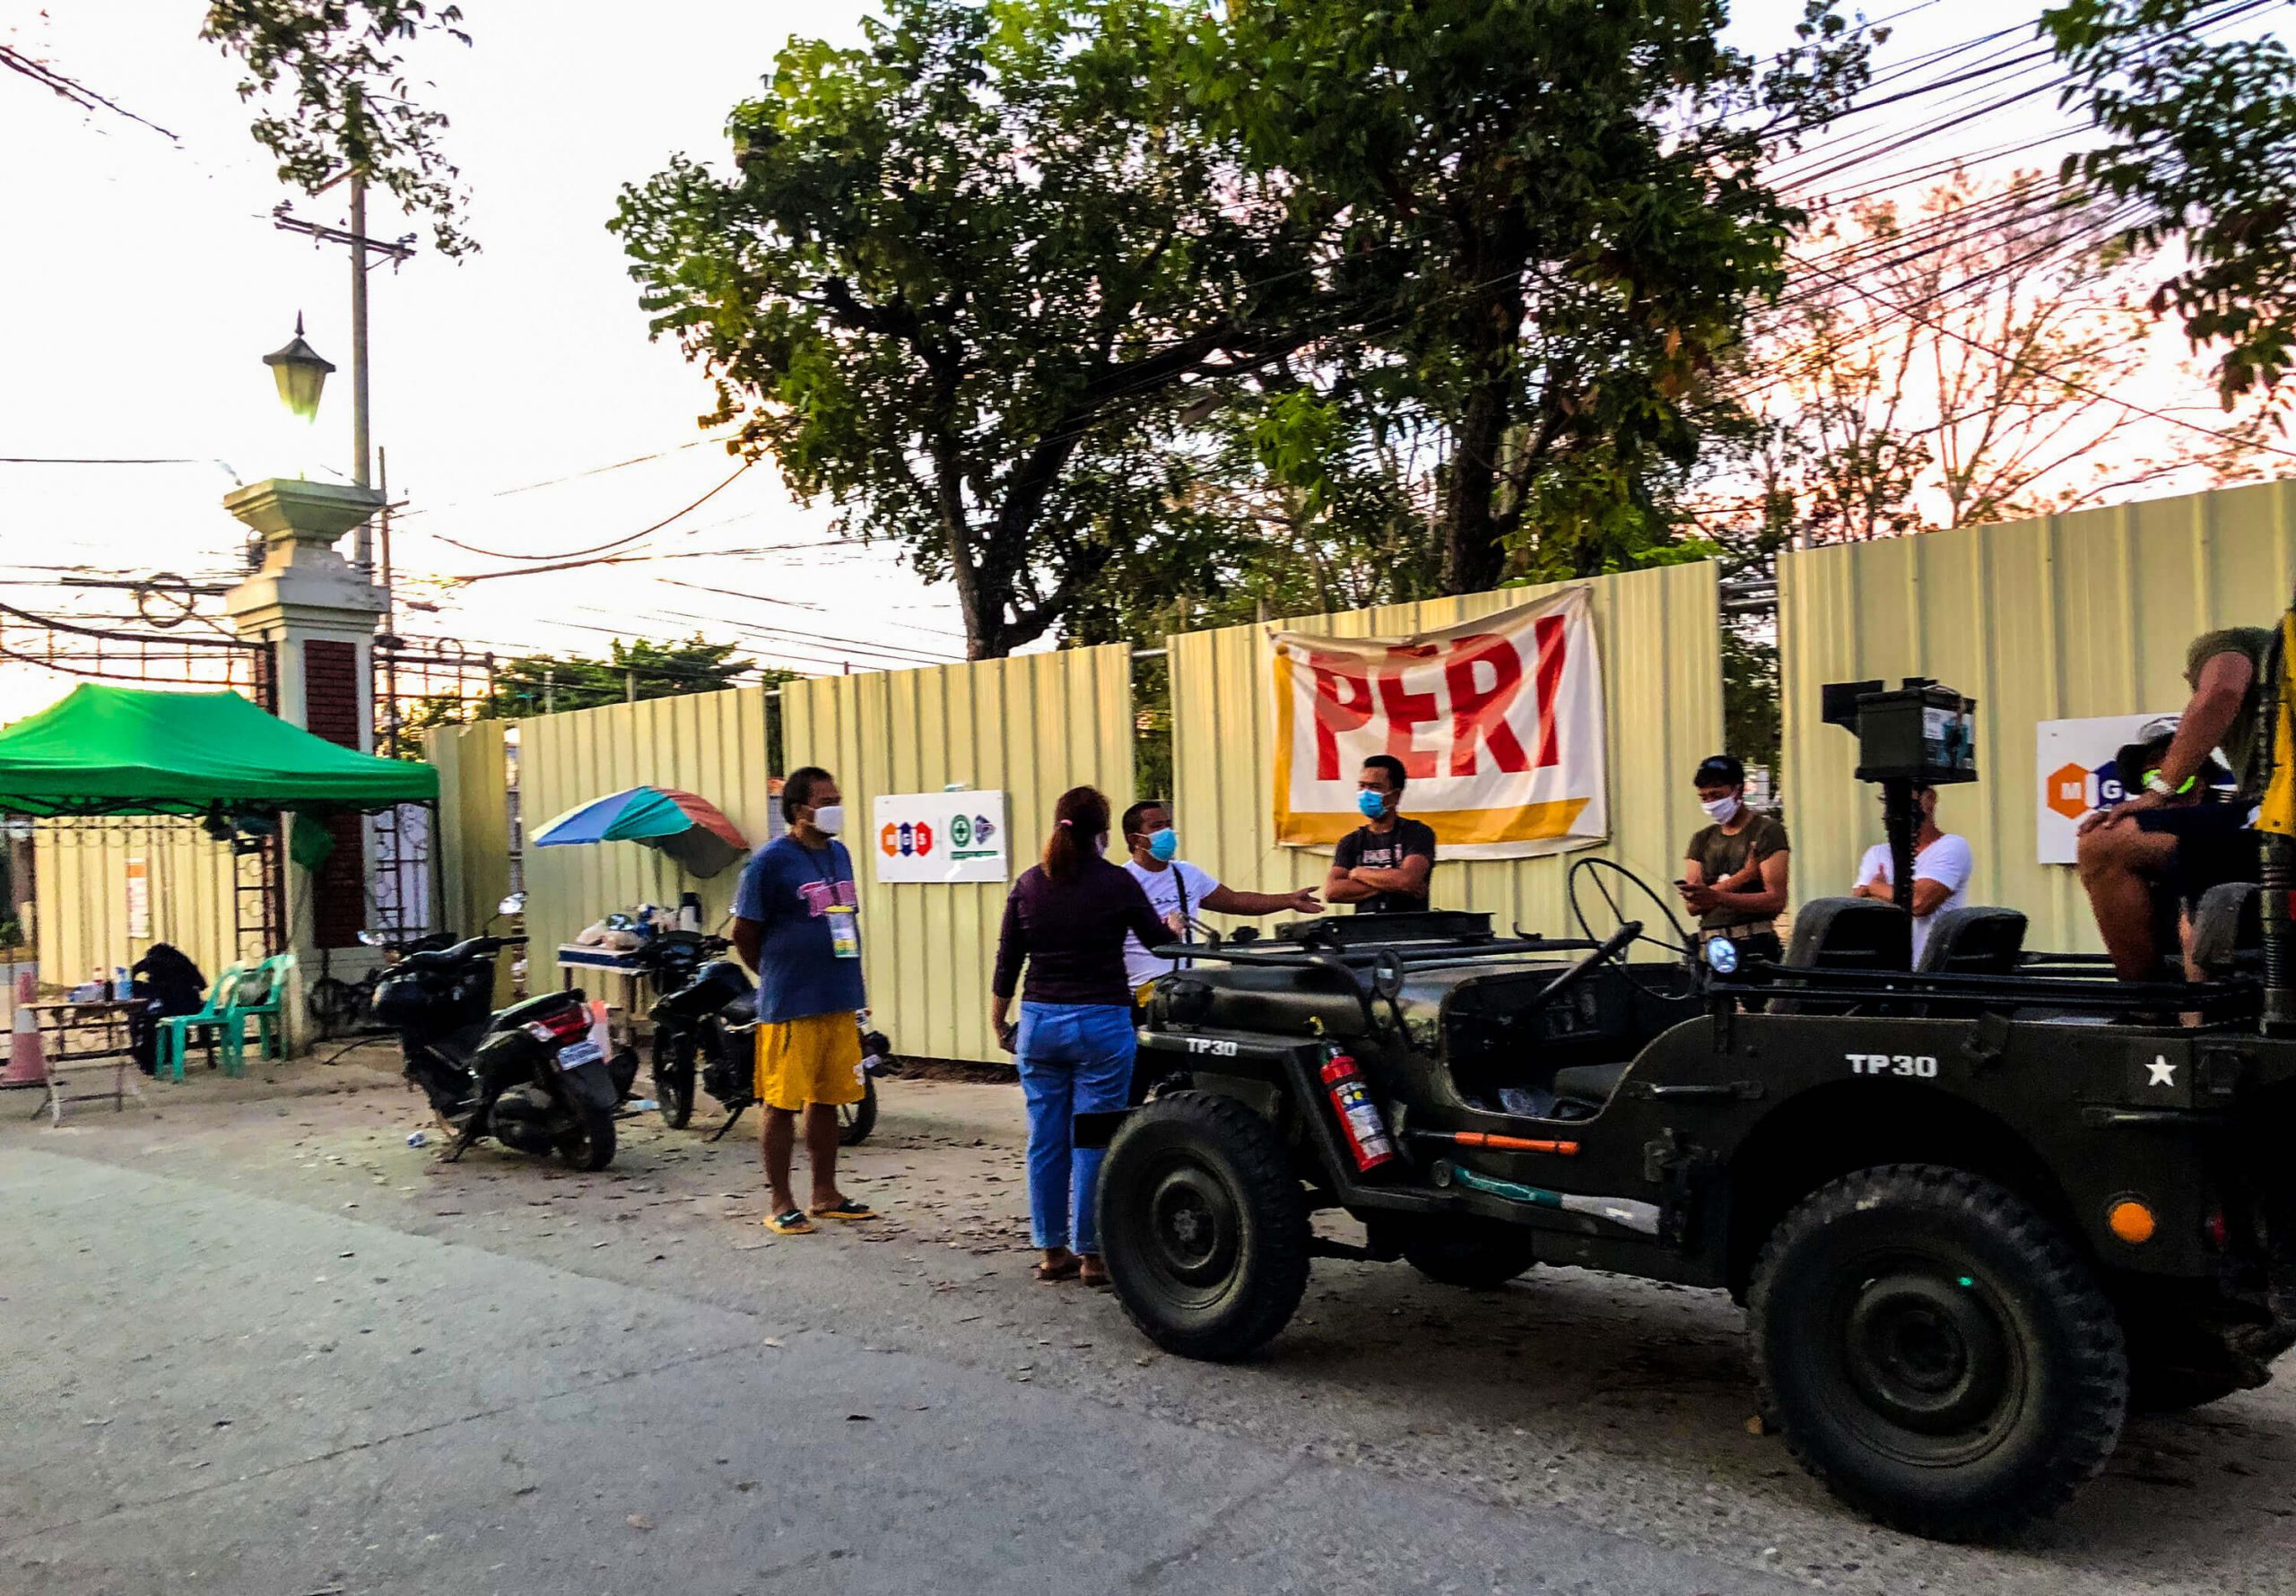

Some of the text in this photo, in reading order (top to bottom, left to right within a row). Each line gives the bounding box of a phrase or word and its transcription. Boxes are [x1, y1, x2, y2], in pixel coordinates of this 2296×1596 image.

[1309, 614, 1566, 780] PERI
[1186, 1037, 1238, 1056] TP30
[1845, 1054, 1937, 1077] TP30
